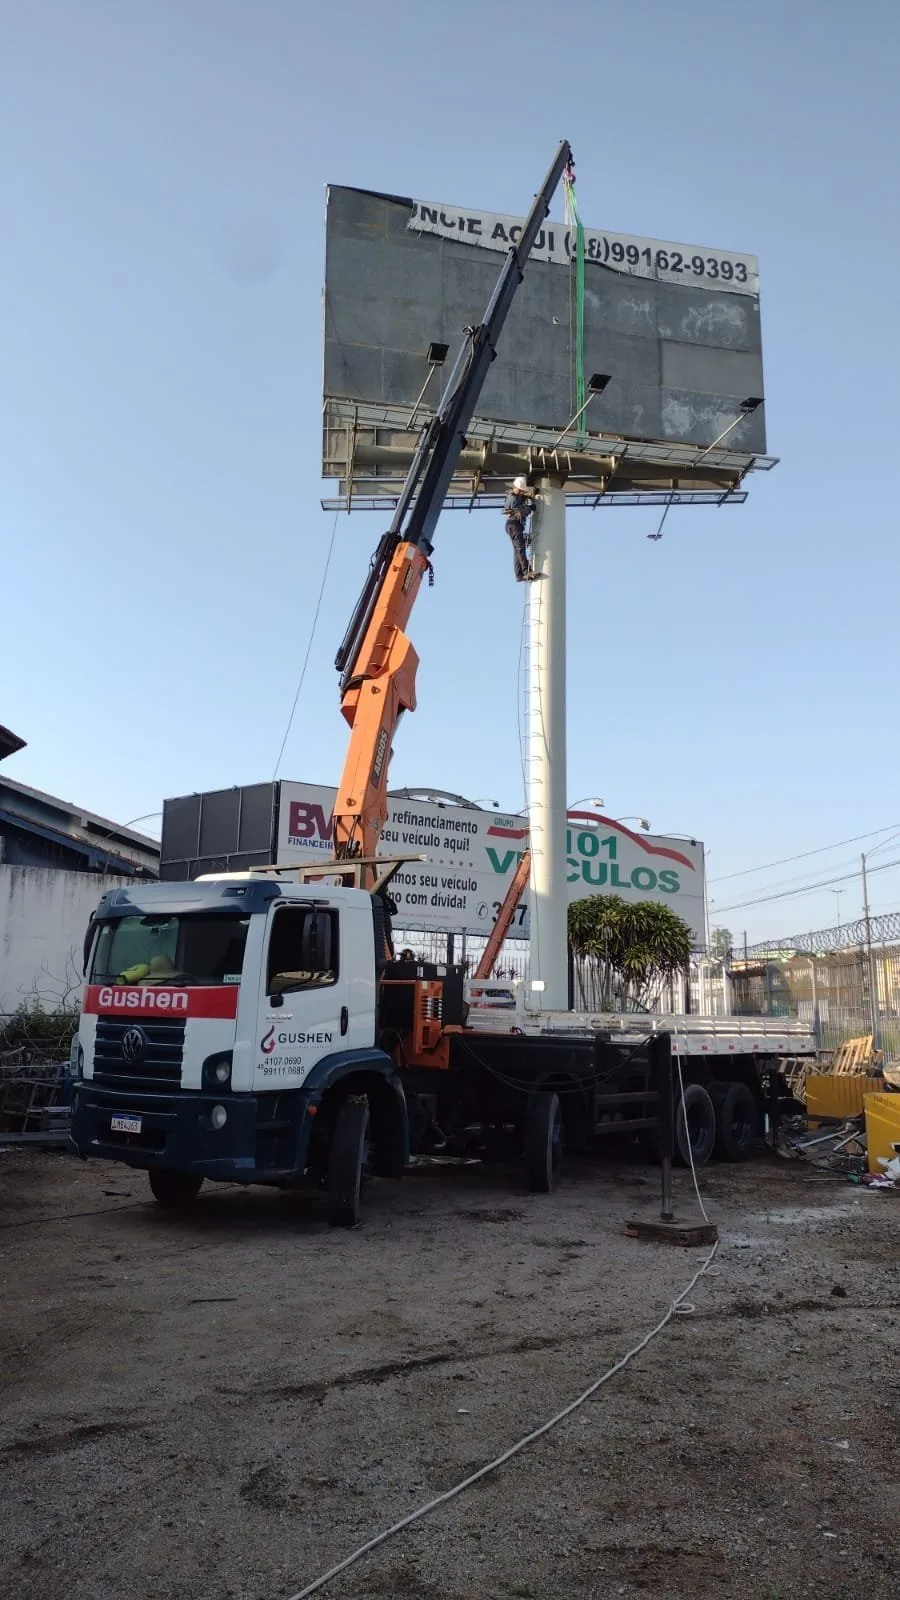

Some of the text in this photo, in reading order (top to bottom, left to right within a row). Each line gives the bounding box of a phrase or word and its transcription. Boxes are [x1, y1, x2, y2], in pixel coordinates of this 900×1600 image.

[374, 729, 388, 777] ARGOS
[289, 801, 334, 840] BV
[392, 811, 478, 834] refinanciamento
[494, 817, 514, 828] GRUPO
[380, 829, 470, 854] seu veículo aqui!
[419, 874, 438, 887] seu
[441, 874, 478, 891] veículo
[405, 891, 428, 905] com
[431, 891, 466, 909] dívida!
[98, 987, 189, 1009] Gushen
[278, 1033, 333, 1043] GUSHEN
